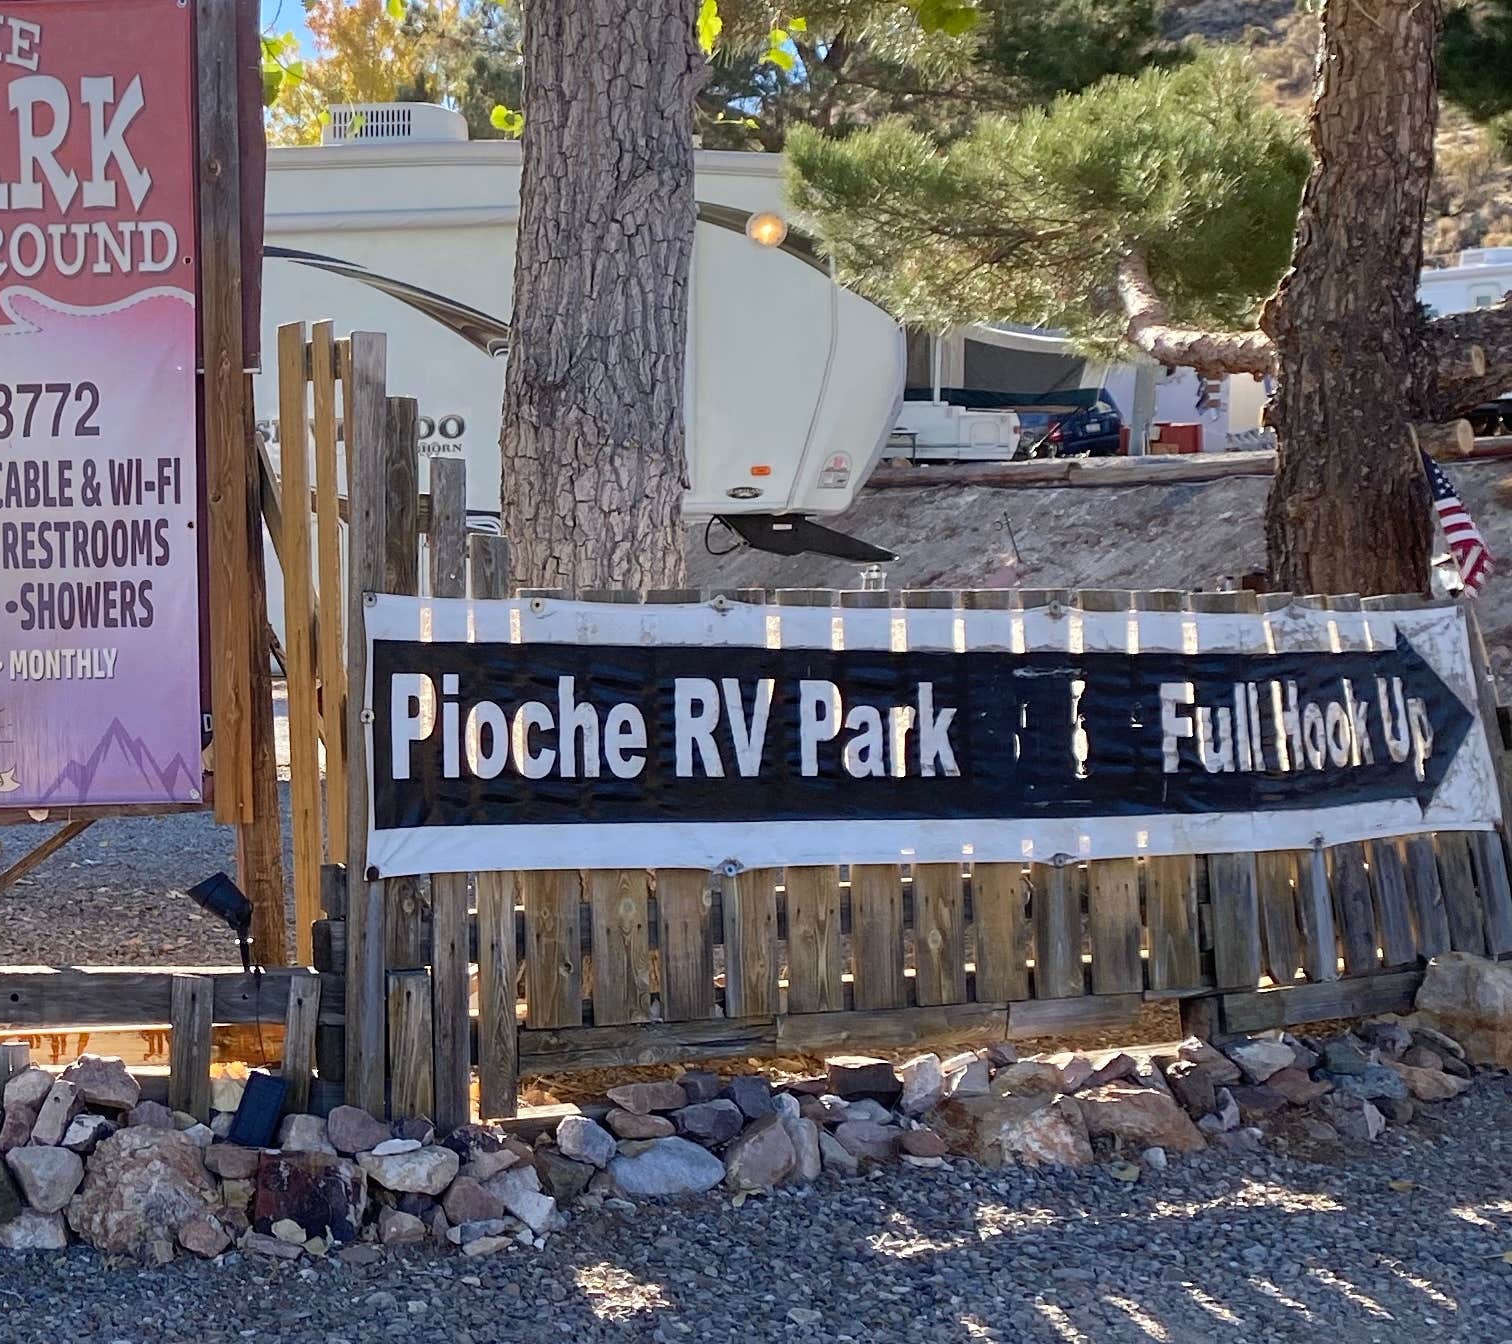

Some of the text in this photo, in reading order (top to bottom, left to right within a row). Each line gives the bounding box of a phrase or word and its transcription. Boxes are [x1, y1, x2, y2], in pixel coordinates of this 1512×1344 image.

[80, 458, 102, 507] &
[108, 457, 182, 507] WI-FI
[2, 518, 171, 570] RESTROOMS
[20, 579, 155, 632] SHOWERS
[9, 646, 119, 682] MONTHLY
[390, 673, 1435, 783] Pioche RV Park Full Hook Up
